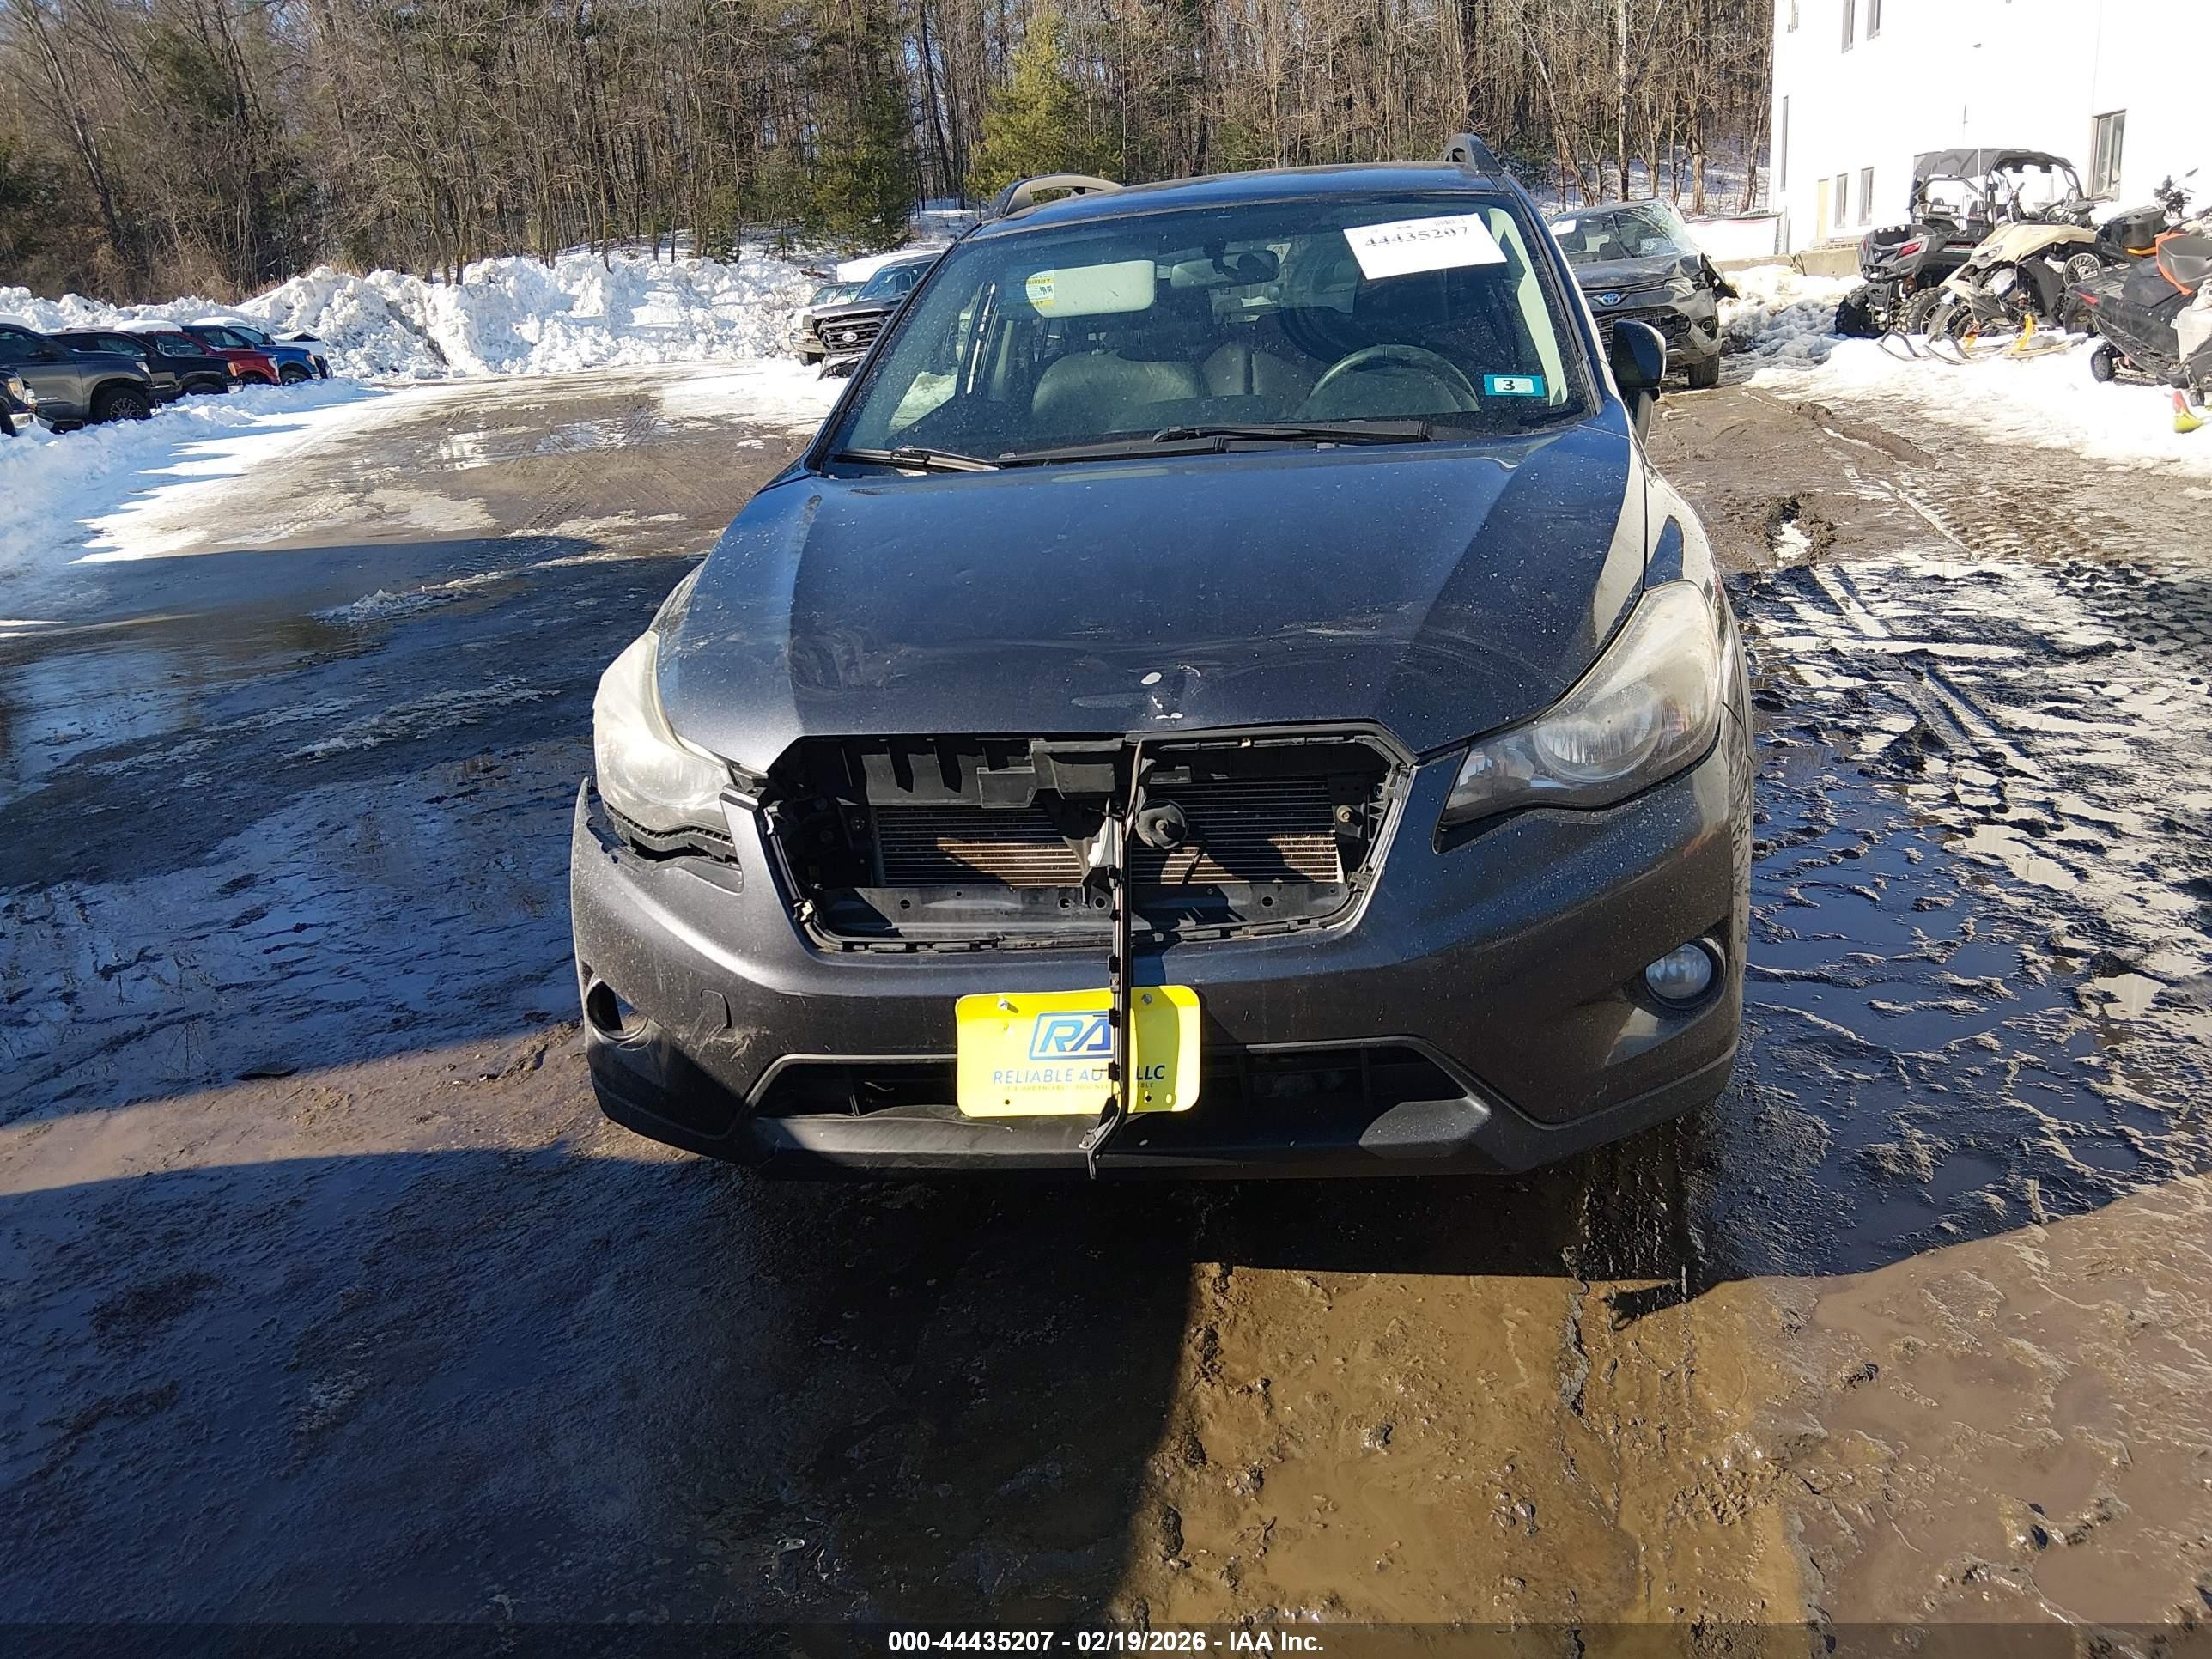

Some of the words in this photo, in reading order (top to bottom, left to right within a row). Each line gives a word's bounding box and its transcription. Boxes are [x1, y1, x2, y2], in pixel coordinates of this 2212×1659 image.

[1365, 227, 1468, 246] 44435207
[1502, 379, 1516, 391] 3
[994, 1068, 1074, 1084] RELIABLE
[1135, 1065, 1165, 1080] LLC
